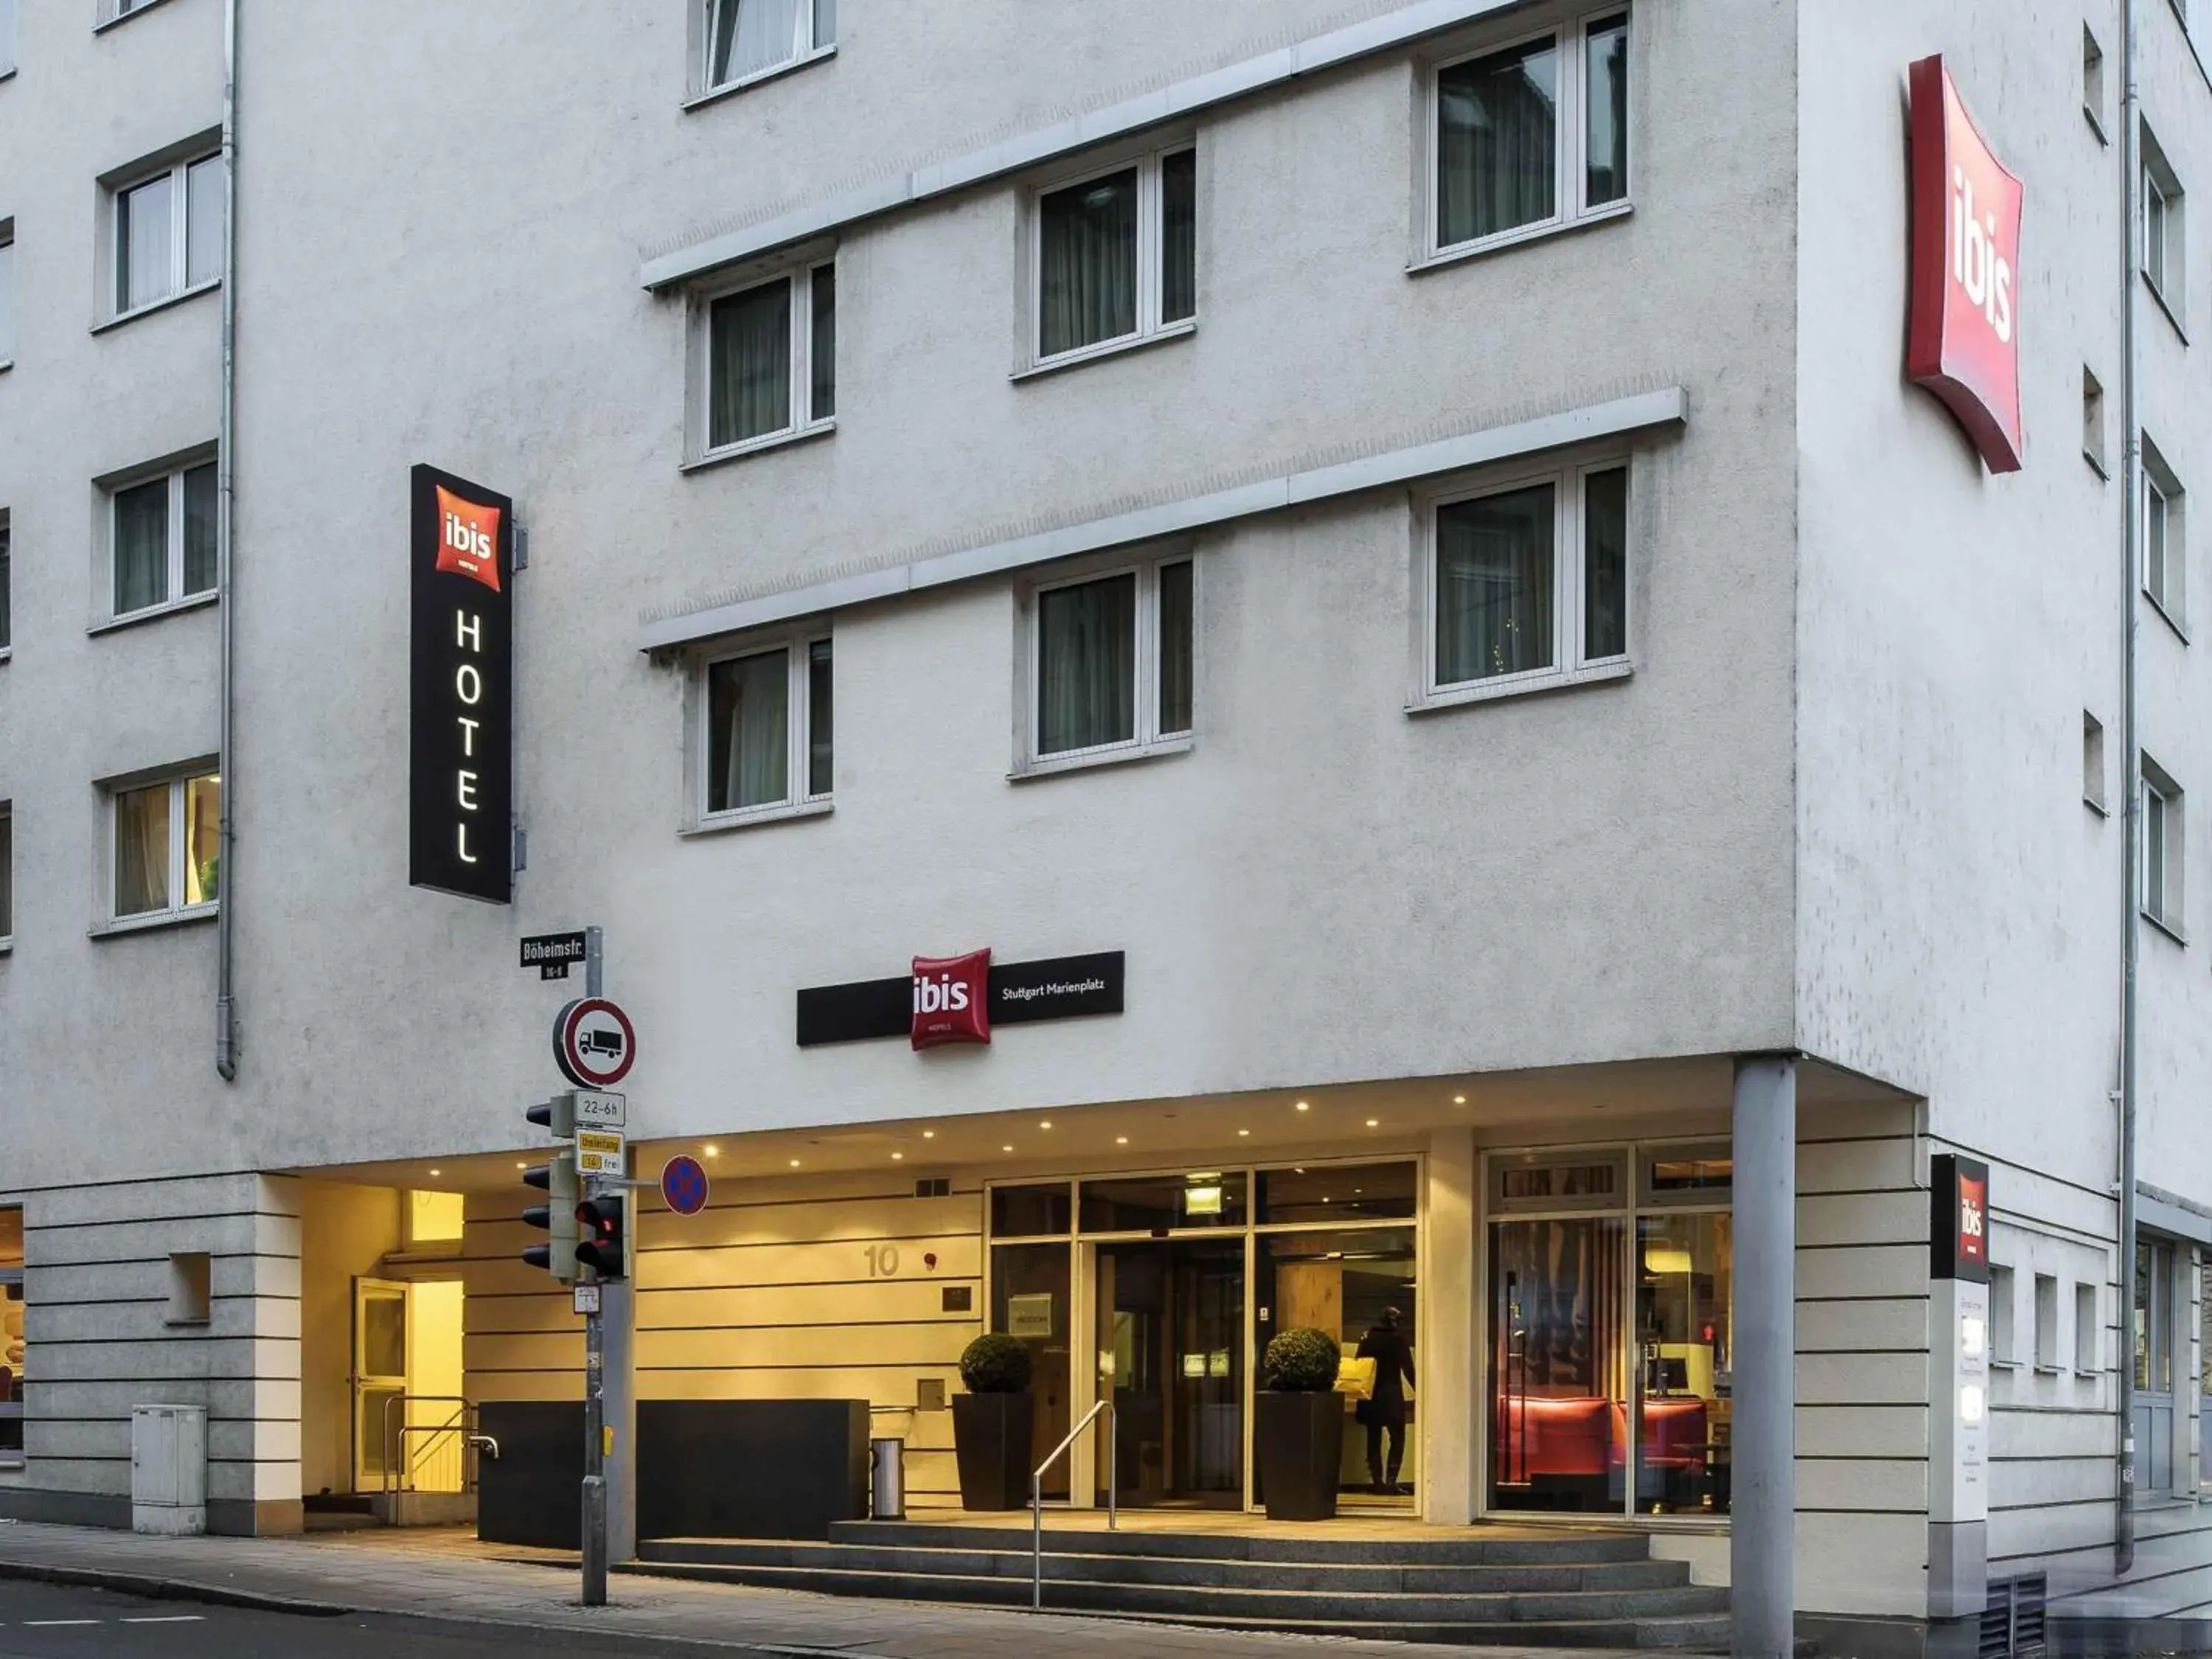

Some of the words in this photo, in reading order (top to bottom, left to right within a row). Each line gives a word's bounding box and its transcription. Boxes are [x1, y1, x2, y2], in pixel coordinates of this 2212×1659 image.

[1954, 164, 2010, 343] ibis
[445, 511, 491, 560] ibis
[456, 609, 481, 863] HOTEL
[524, 938, 582, 960] Böheimstr.
[914, 973, 968, 1013] ibis
[1002, 984, 1045, 1000] Stuttgart
[1046, 978, 1105, 995] Marienplatz
[604, 1158, 621, 1169] fre
[1961, 1197, 1982, 1237] ibis
[864, 1245, 899, 1277] 10
